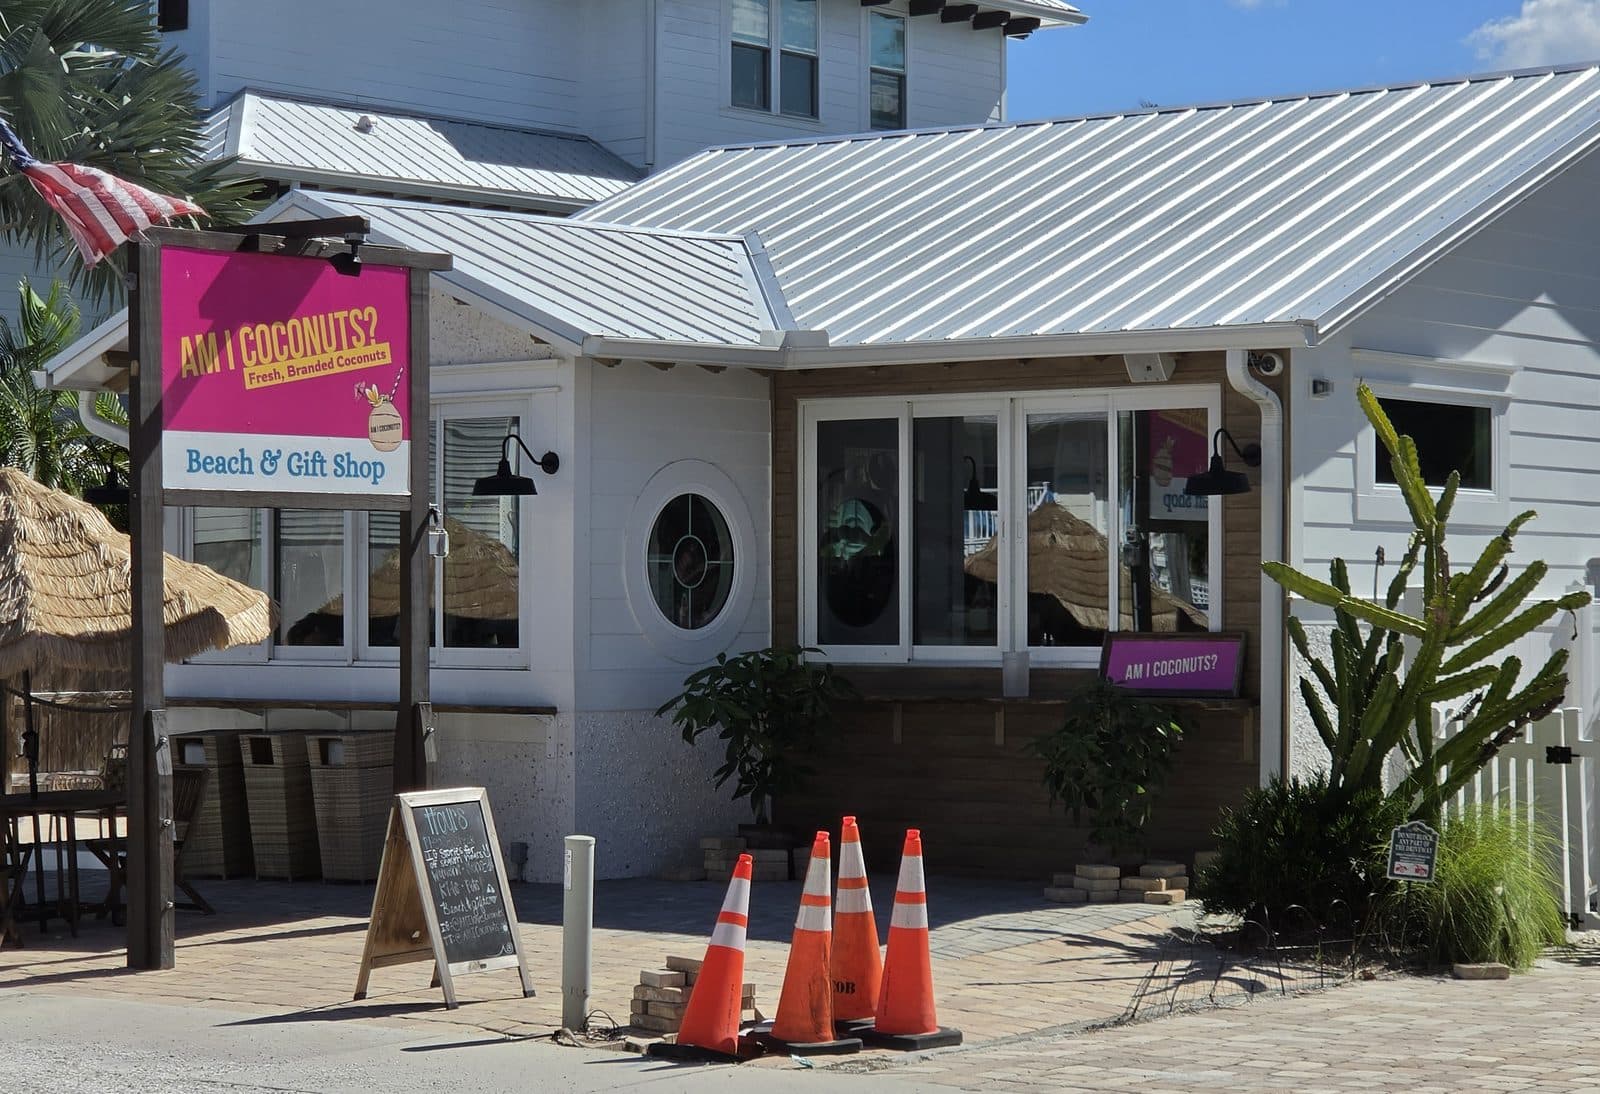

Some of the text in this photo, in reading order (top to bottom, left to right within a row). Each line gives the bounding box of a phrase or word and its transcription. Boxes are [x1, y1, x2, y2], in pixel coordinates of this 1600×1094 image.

[180, 305, 379, 379] AM I COCONUTS?
[248, 349, 388, 386] Fresh, Branded Coconuts
[186, 448, 386, 485] Beach & Gift Shop
[1125, 654, 1218, 681] AM I COCONUTS?
[424, 807, 469, 836] Hours
[1405, 846, 1432, 854] DRIVEWAY
